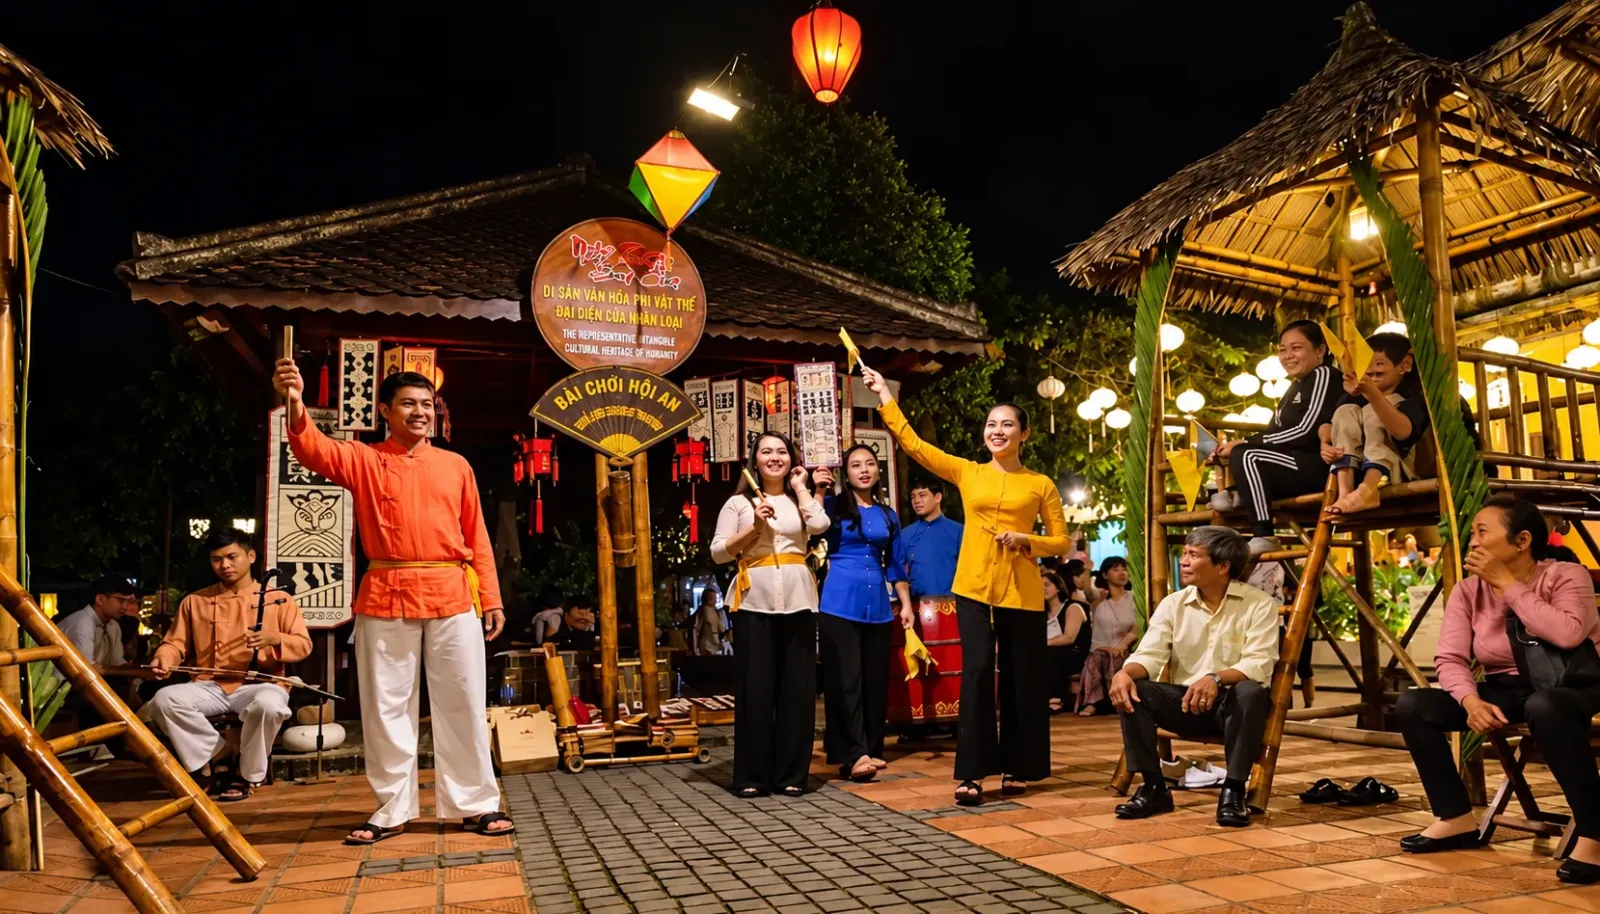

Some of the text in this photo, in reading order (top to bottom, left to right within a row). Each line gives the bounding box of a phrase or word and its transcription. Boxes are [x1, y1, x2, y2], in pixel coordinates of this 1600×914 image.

[543, 284, 554, 298] DI
[633, 294, 651, 308] PHI
[555, 305, 575, 322] ĐẠI
[661, 315, 683, 332] LOẠI
[563, 328, 576, 340] THE
[579, 330, 636, 345] REPRESENTATIVE
[565, 343, 600, 355] CULTURAL
[635, 347, 644, 357] OF
[553, 386, 583, 411] BÀI
[628, 379, 658, 400] HỘI
[657, 390, 682, 413] AN
